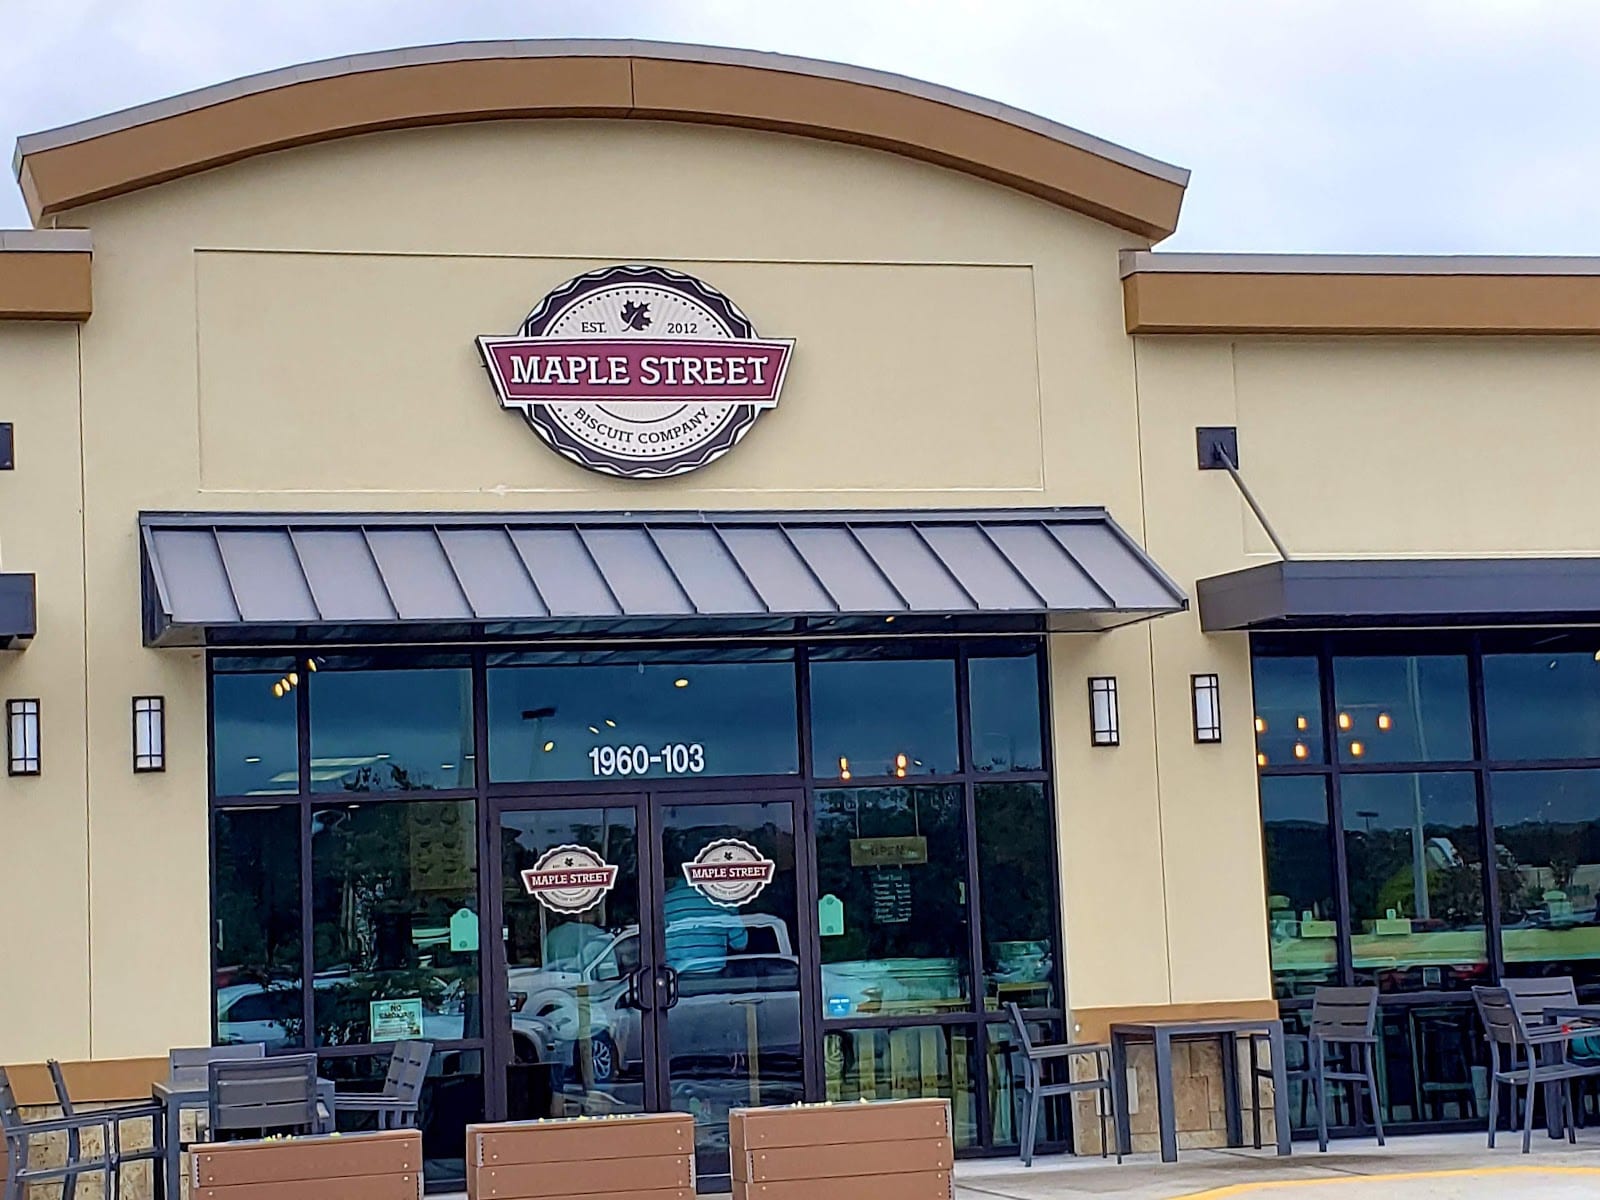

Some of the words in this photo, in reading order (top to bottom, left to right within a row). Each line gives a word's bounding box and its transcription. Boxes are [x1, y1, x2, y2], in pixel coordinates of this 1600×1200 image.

[581, 322, 607, 334] EST.
[667, 322, 698, 334] 2012
[510, 355, 630, 384] MAPLE
[640, 356, 769, 385] STREET
[574, 407, 633, 444] BISCUIT
[638, 408, 710, 445] COMPANY
[588, 743, 705, 776] 1960-103
[531, 874, 568, 886] MAPLE
[570, 871, 609, 884] STREET
[691, 867, 727, 879] MAPLE
[729, 866, 767, 877] STREET
